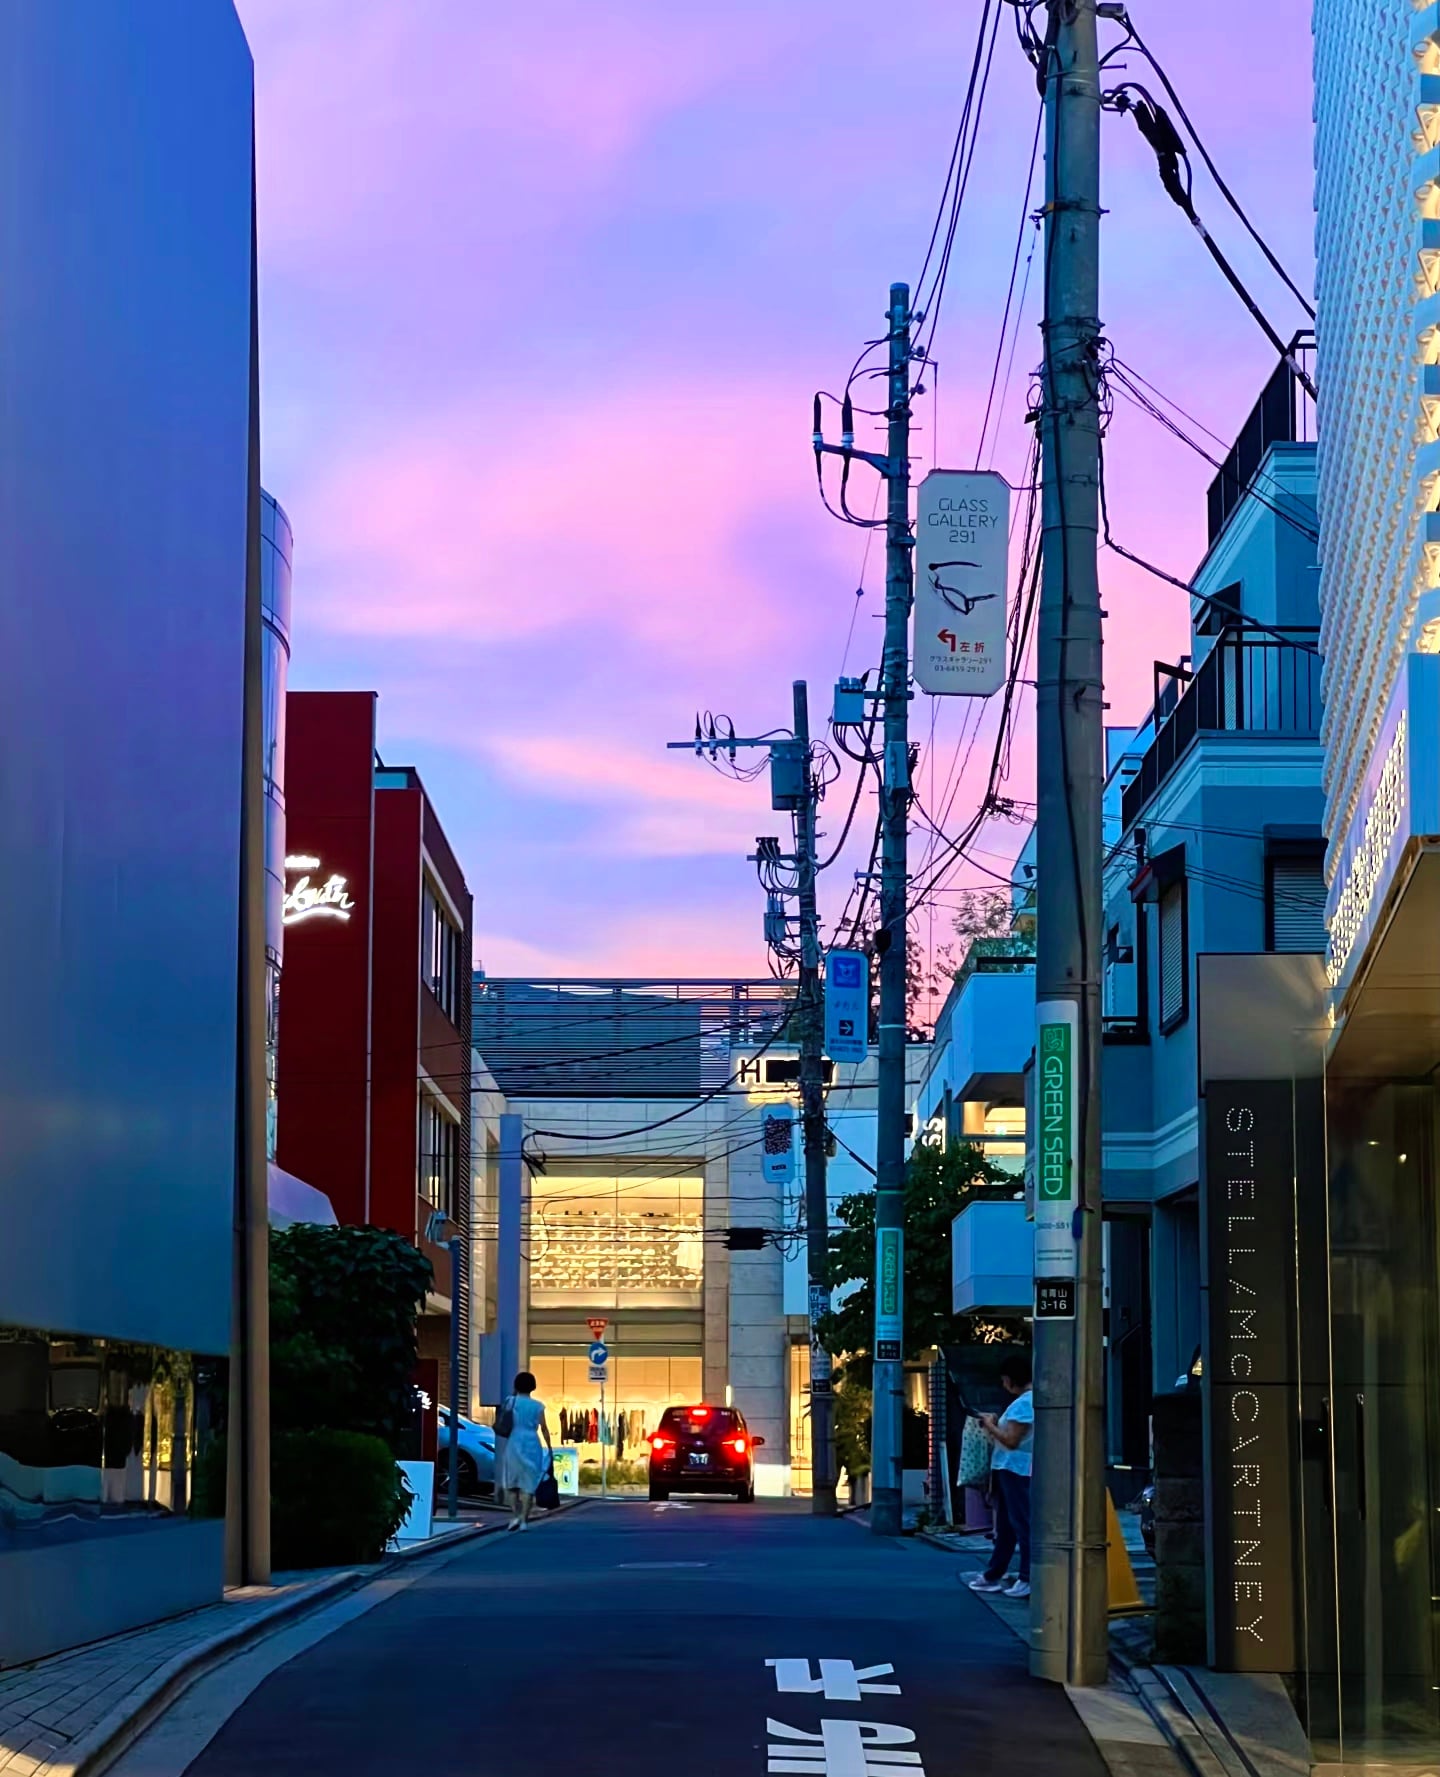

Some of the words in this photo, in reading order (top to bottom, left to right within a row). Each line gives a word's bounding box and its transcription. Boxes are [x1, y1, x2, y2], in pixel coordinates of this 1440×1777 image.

[938, 498, 989, 513] GLASS
[927, 513, 999, 529] GALLERY
[949, 530, 977, 545] 291
[959, 642, 985, 654] 左折
[1044, 1056, 1063, 1132] GREEN
[1043, 1136, 1062, 1195] SEED
[1040, 1300, 1067, 1311] 3-16
